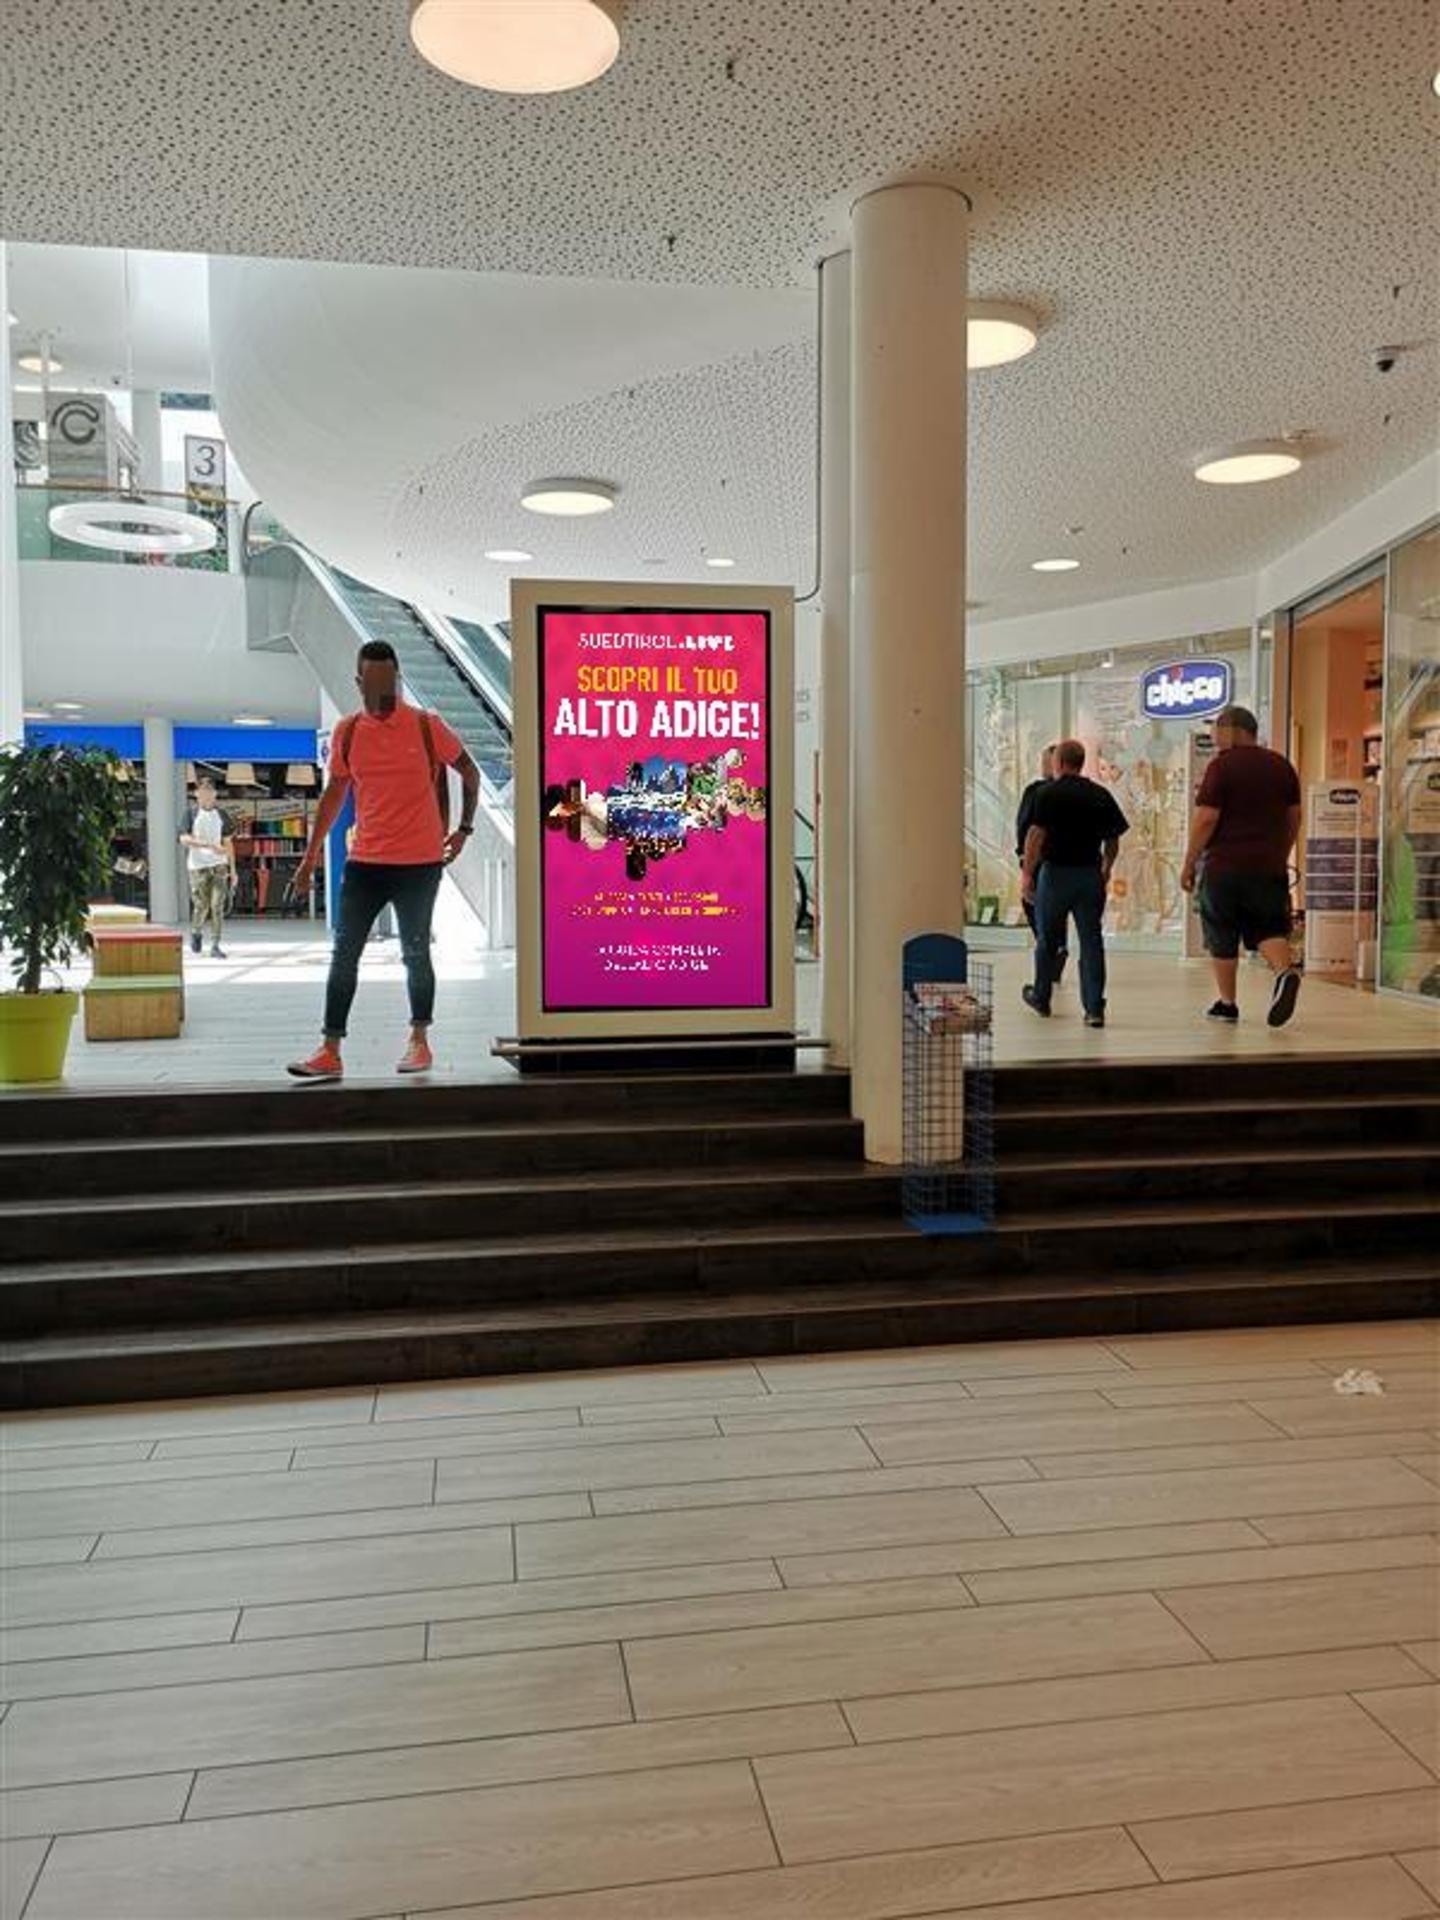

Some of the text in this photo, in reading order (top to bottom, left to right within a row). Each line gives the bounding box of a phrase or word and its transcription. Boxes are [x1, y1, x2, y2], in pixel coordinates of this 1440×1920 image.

[194, 445, 217, 477] 3
[578, 666, 738, 694] SCOPRI IL TUO
[1146, 674, 1222, 707] chicco
[553, 698, 638, 738] ALTO
[650, 700, 759, 740] ADIGE!
